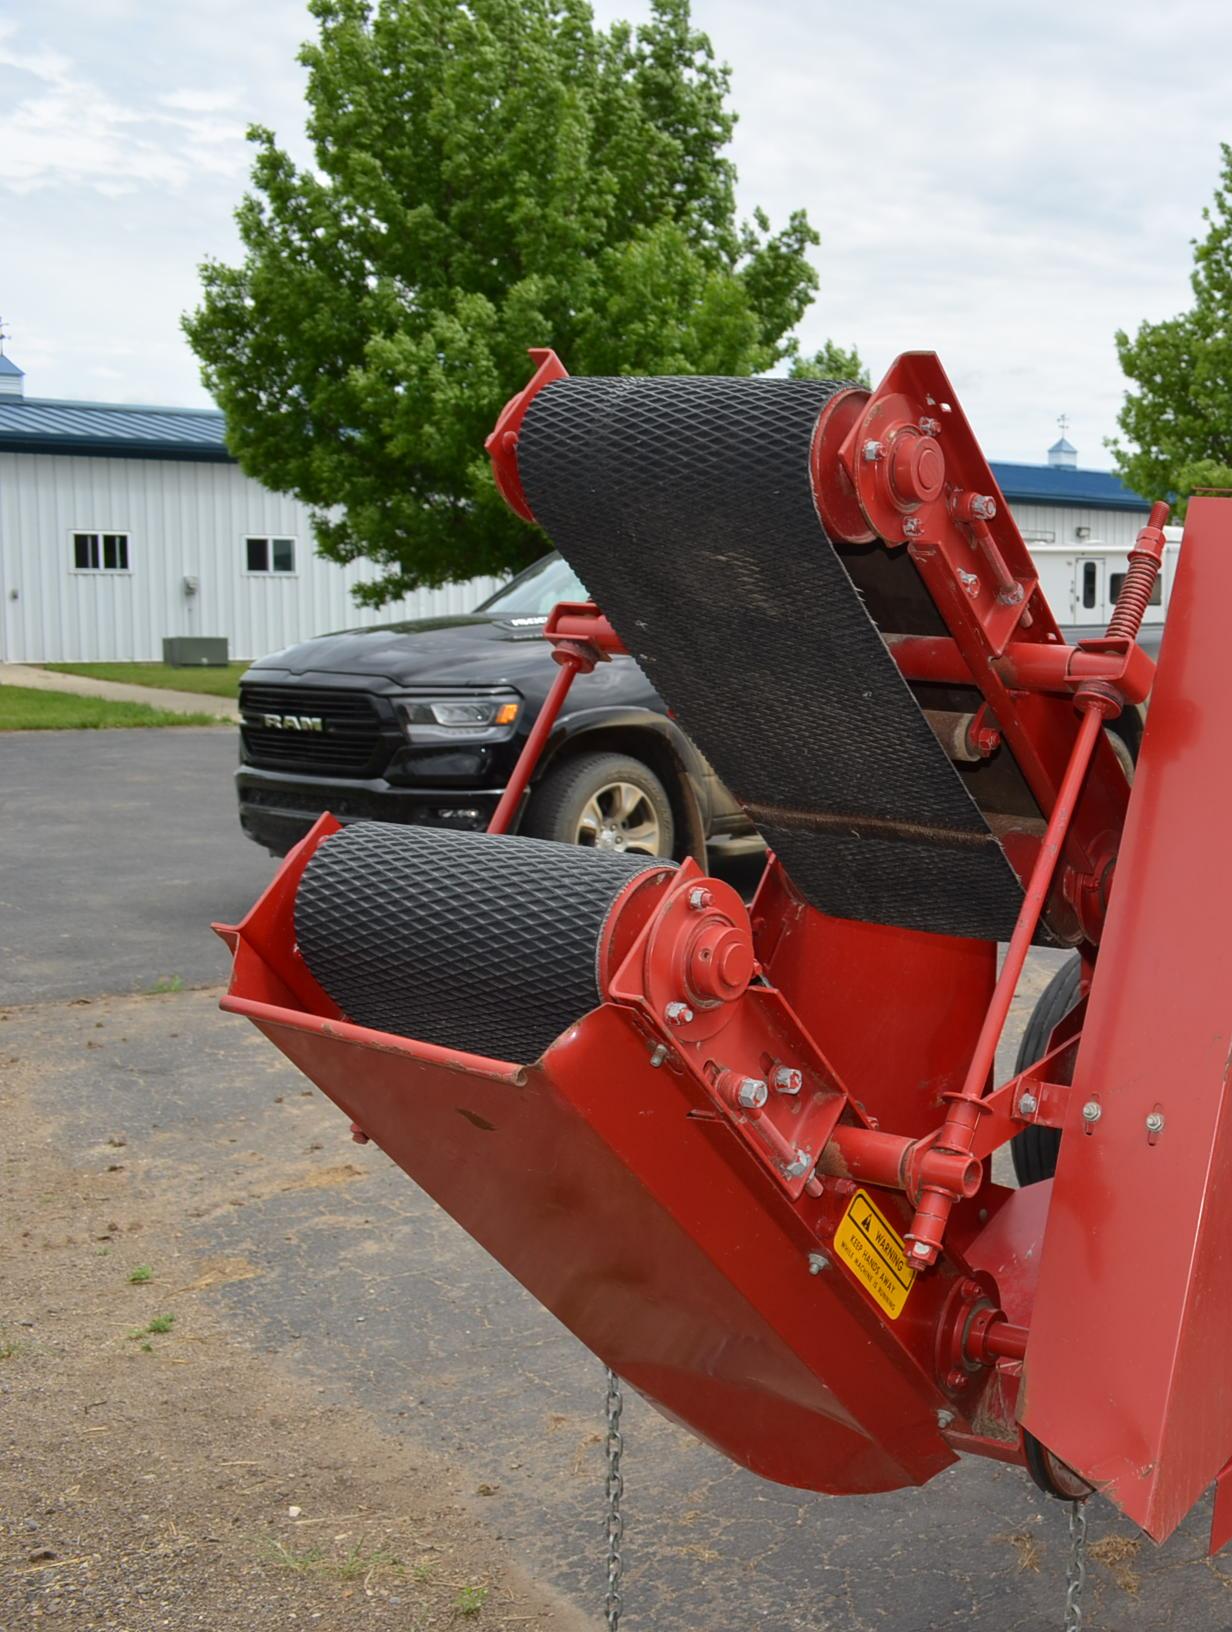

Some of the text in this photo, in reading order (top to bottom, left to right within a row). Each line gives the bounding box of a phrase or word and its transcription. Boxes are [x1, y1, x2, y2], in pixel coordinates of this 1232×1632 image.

[264, 713, 322, 731] RAM
[850, 1234, 896, 1294] KEEP HANDS AWAY
[875, 1230, 904, 1272] WARNING
[872, 1280, 879, 1289] IS
